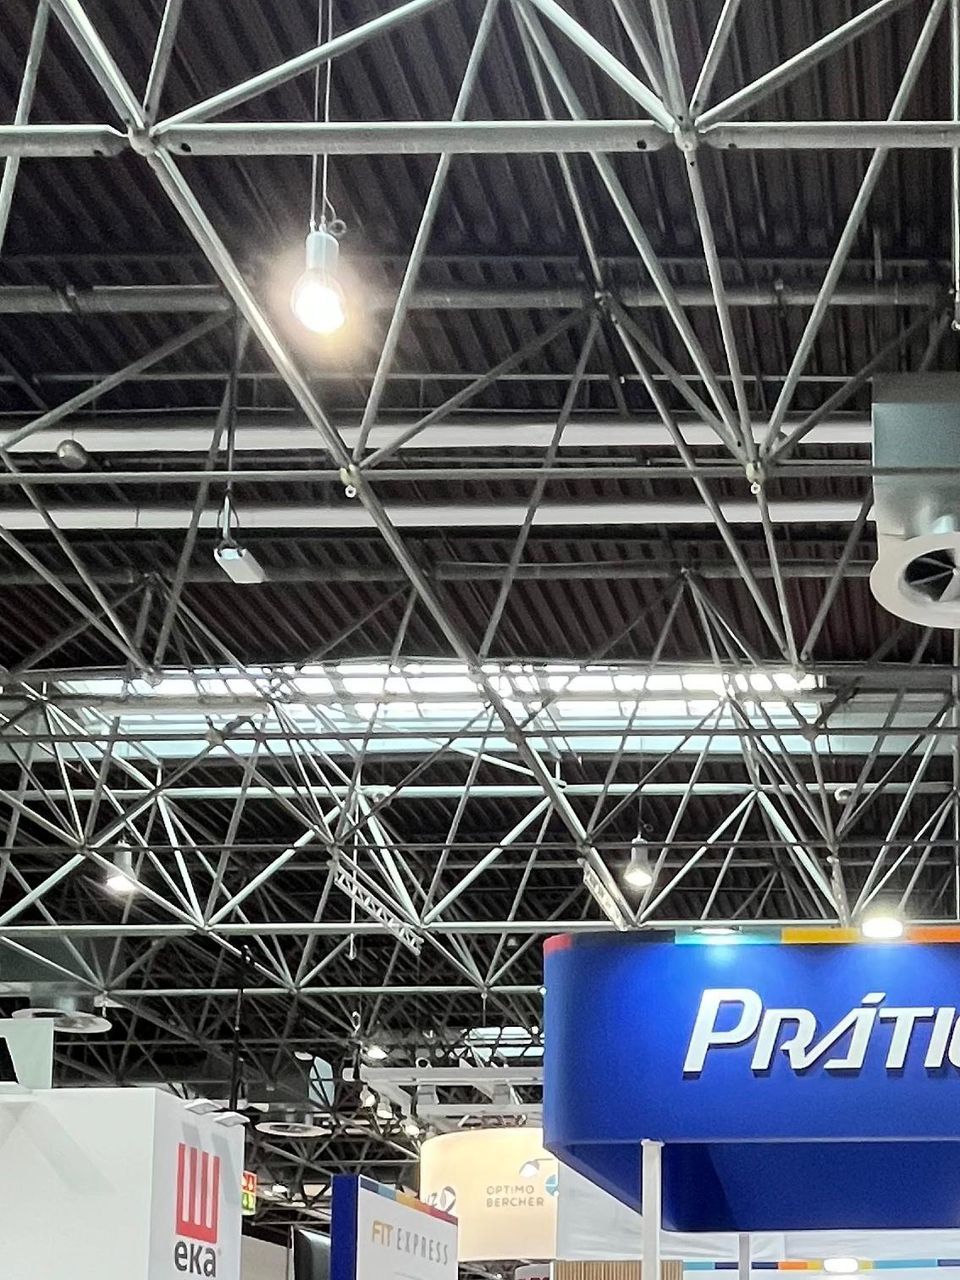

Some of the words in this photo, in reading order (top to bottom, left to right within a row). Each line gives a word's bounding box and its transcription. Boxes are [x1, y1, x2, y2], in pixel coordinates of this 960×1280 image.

[486, 1184, 535, 1196] OPTIMO
[486, 1197, 544, 1208] BERCHER
[372, 1219, 393, 1247] FIT
[396, 1227, 448, 1265] EXPRESS
